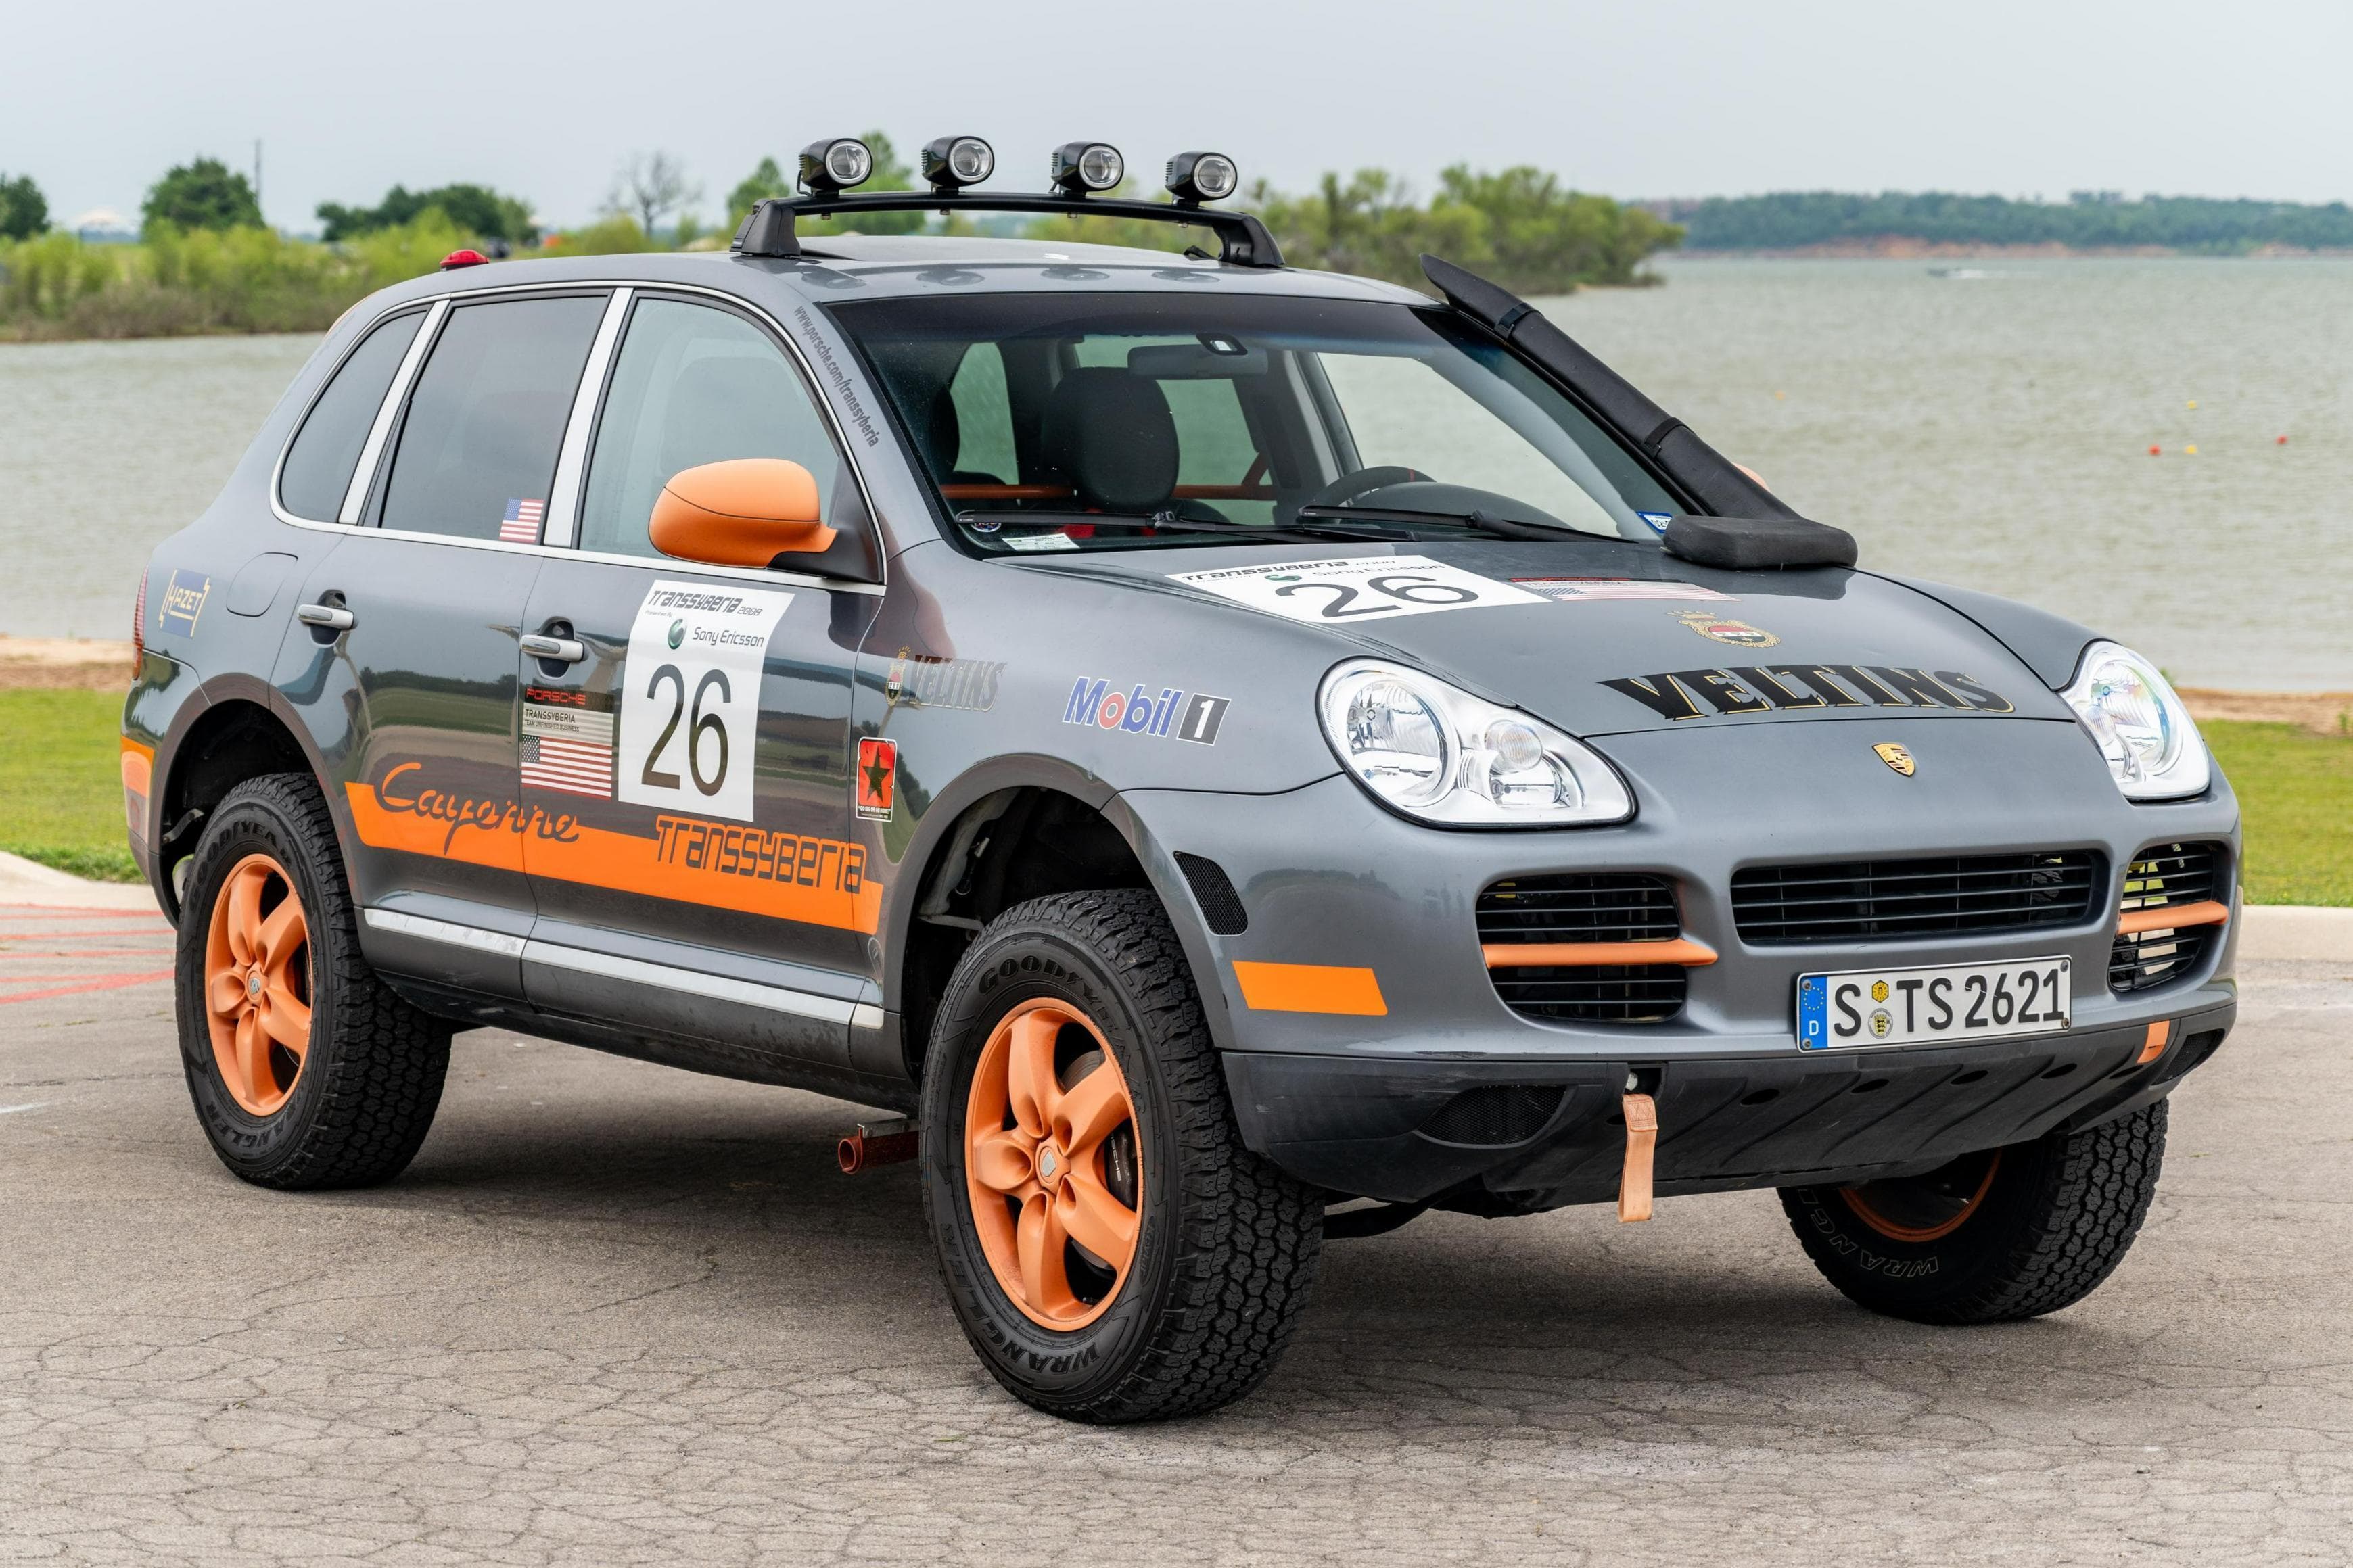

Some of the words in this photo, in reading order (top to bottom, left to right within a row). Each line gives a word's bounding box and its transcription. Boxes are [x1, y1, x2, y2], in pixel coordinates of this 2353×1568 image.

[793, 306, 881, 448] www.porsche.com/transsyberia
[164, 584, 203, 614] HAZET
[737, 607, 764, 616] 2008
[1275, 575, 1479, 618] 26
[693, 627, 720, 646] Sony
[720, 629, 765, 648] Ericsson
[527, 686, 586, 706] PORSCHE
[909, 655, 1008, 712] VELTINS
[1063, 676, 1184, 738] Mobil
[1597, 665, 2016, 722] VELTINS
[525, 709, 576, 723] TRANSSYBERIA
[536, 720, 559, 730] UNFINISHED
[559, 723, 580, 732] BUSINESS
[641, 663, 732, 797] 26
[375, 761, 580, 856] Cayenne
[1809, 1020, 1819, 1036] D
[1834, 983, 1861, 1037] S
[1896, 978, 1953, 1033] TS
[1965, 968, 2064, 1028] 2621
